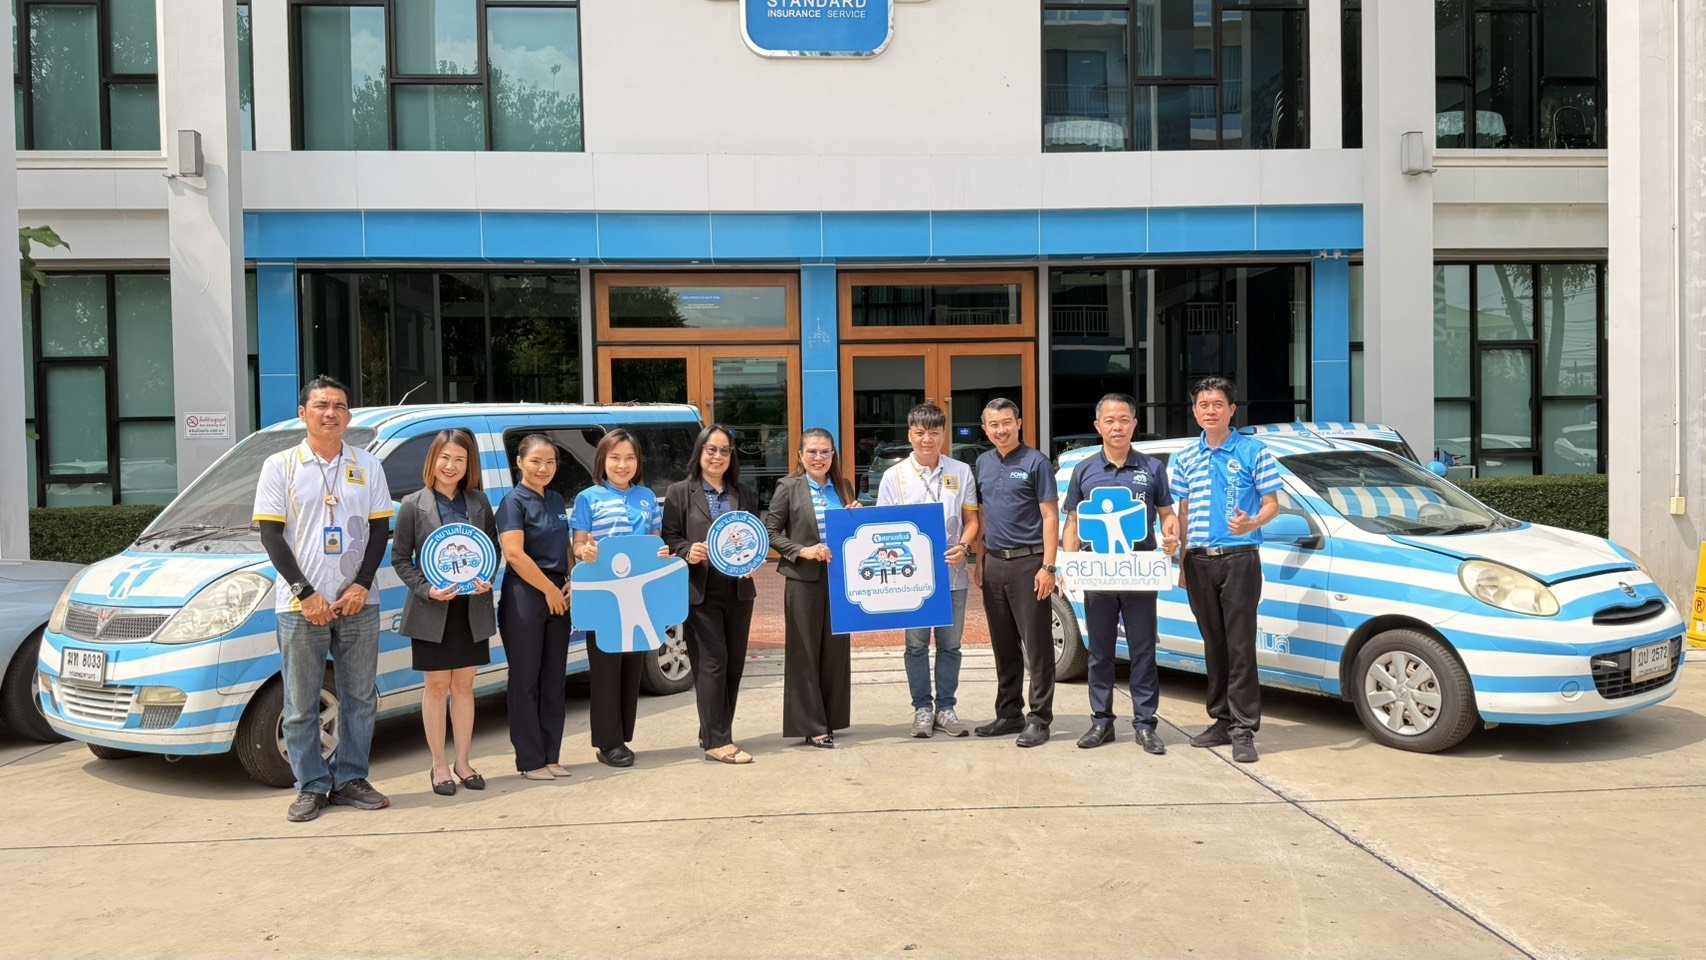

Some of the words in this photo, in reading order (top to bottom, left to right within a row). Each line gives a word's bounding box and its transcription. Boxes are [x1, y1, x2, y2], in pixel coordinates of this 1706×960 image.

[767, 0, 867, 8] STANDARD
[767, 9, 821, 18] INSURANCE
[827, 10, 867, 19] SERVICE
[1065, 553, 1168, 578] สยามสไมล์
[82, 653, 102, 669] 8033
[1651, 645, 1668, 662] 2572
